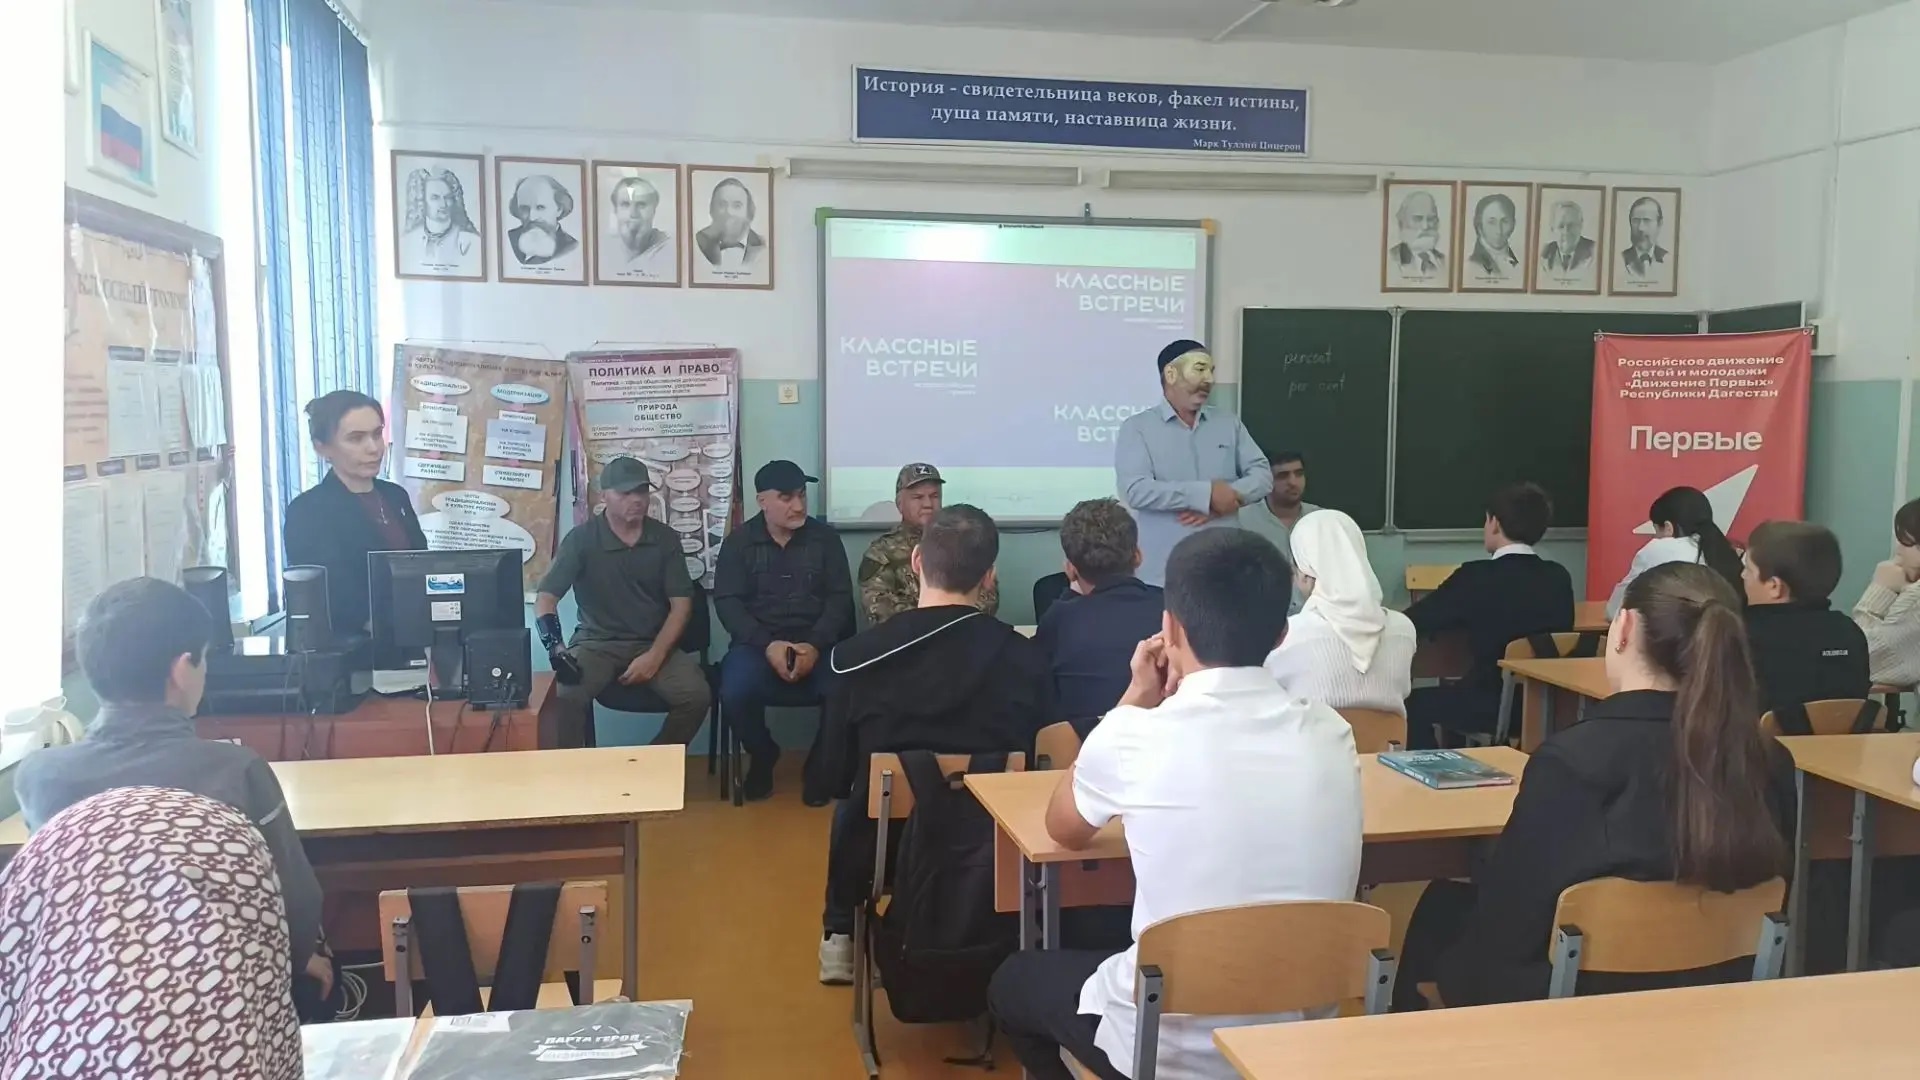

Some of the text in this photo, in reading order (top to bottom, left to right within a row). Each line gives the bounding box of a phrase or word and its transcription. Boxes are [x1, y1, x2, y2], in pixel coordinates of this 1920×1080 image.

[863, 76, 945, 95] История
[962, 82, 1101, 103] свидетельница
[1107, 89, 1163, 107] веков,
[1168, 90, 1223, 109] факел
[1228, 96, 1300, 113] истины,
[931, 106, 1237, 132] душа памяти, наставница жизни.
[1193, 139, 1301, 152] Марк Туллий Цицерон
[1056, 272, 1185, 293] КЛАССНЫЕ
[1079, 295, 1185, 314] ВСТРЕЧИ
[840, 336, 978, 357] КЛАССНЫЕ
[1618, 356, 1784, 367] Российское движение
[589, 363, 720, 377] ПОЛИТИКА И ПРАВО
[866, 359, 978, 378] ВСТРЕЧИ
[1632, 367, 1674, 378] детей
[1689, 367, 1767, 378] молодежи
[1626, 378, 1774, 389] «Движение Первых»
[1620, 389, 1778, 400] Республики Дагестан
[637, 403, 678, 412] ПРИРОДА
[634, 413, 682, 422] ОБЩЕСТВО
[1630, 426, 1763, 458] Первые
[544, 1036, 592, 1045] ПАРТА
